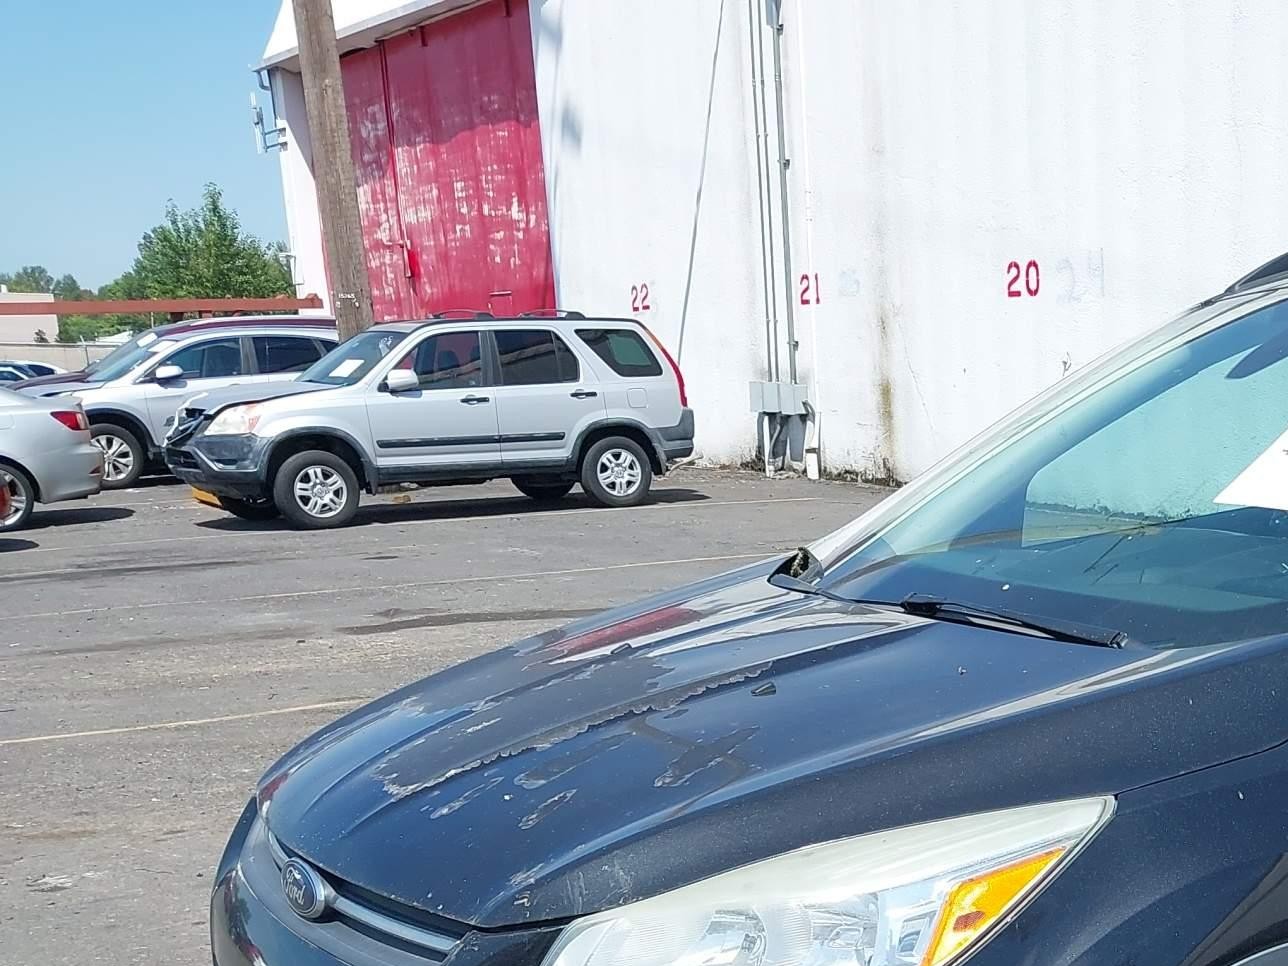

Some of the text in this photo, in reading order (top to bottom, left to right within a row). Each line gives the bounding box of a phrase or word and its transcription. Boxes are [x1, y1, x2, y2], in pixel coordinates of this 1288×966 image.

[799, 272, 821, 305] 21
[1007, 259, 1040, 297] 20
[631, 282, 650, 312] 22
